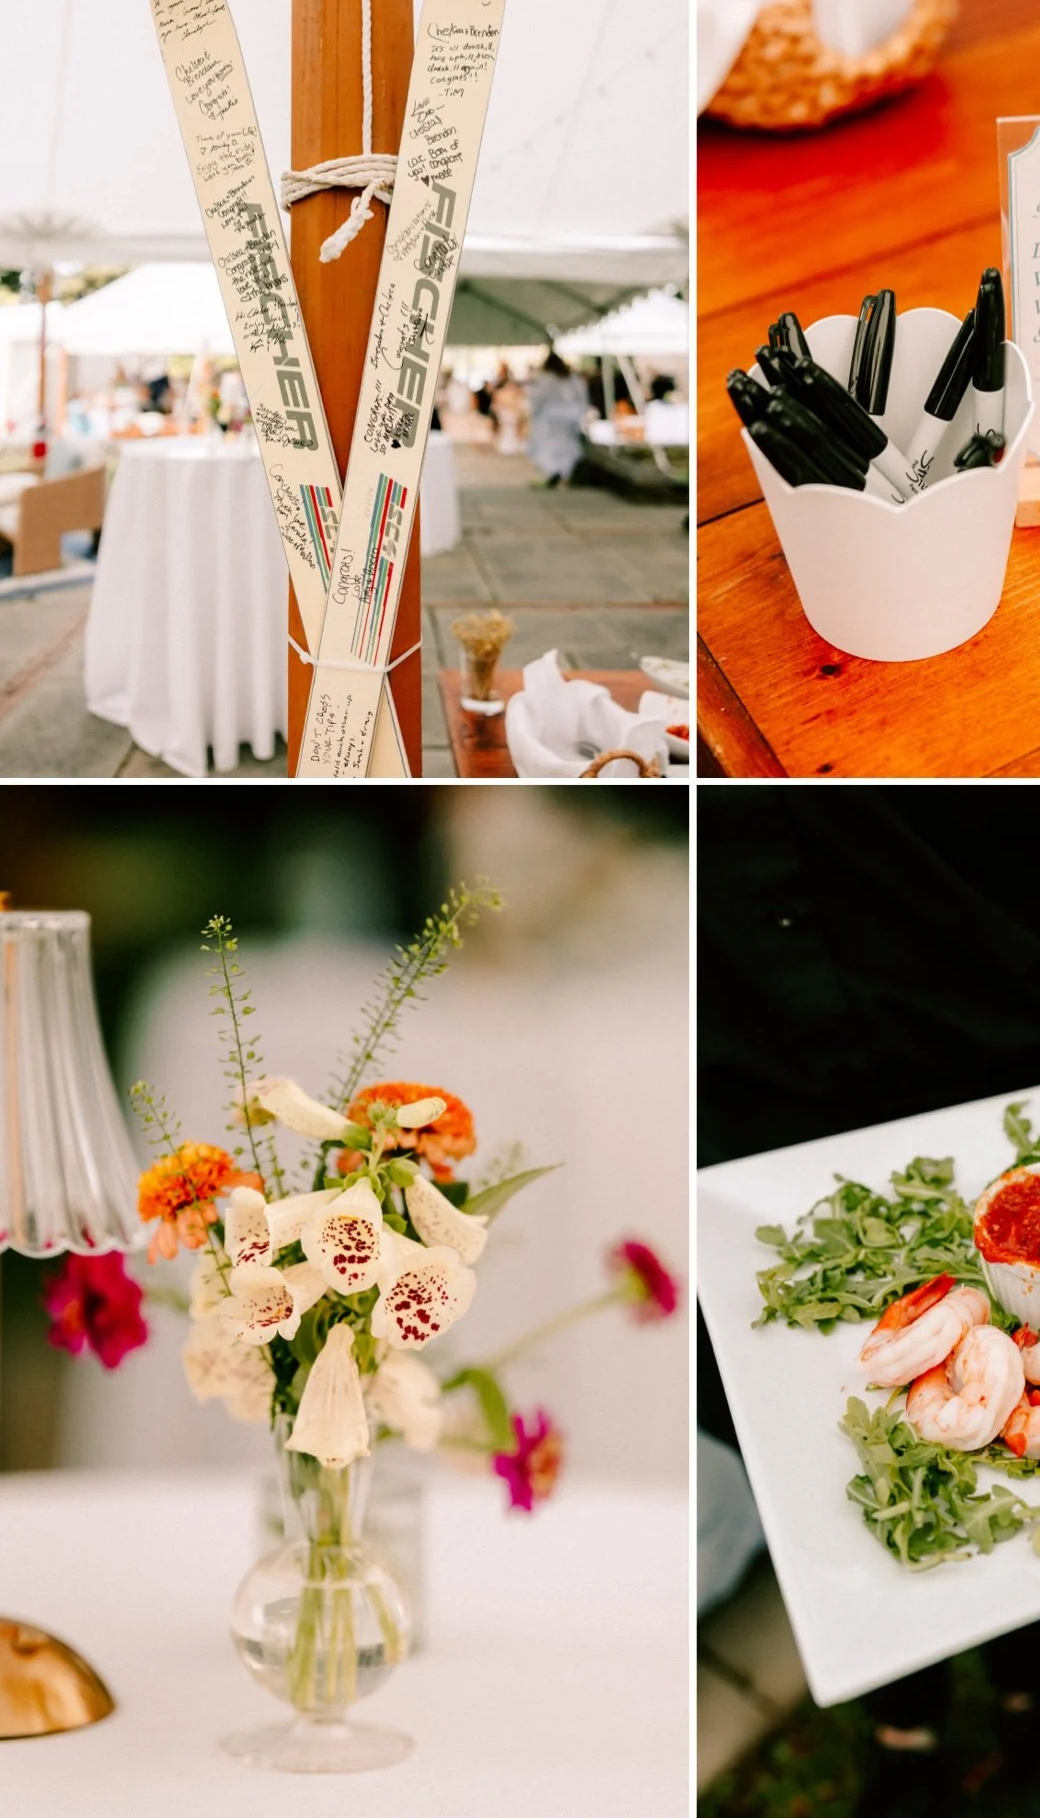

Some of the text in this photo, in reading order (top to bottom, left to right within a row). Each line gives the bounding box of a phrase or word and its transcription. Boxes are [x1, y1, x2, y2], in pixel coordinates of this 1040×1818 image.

[427, 21, 464, 44] Chelsea
[238, 202, 319, 451] FISCHER
[390, 181, 457, 449] FISCHER
